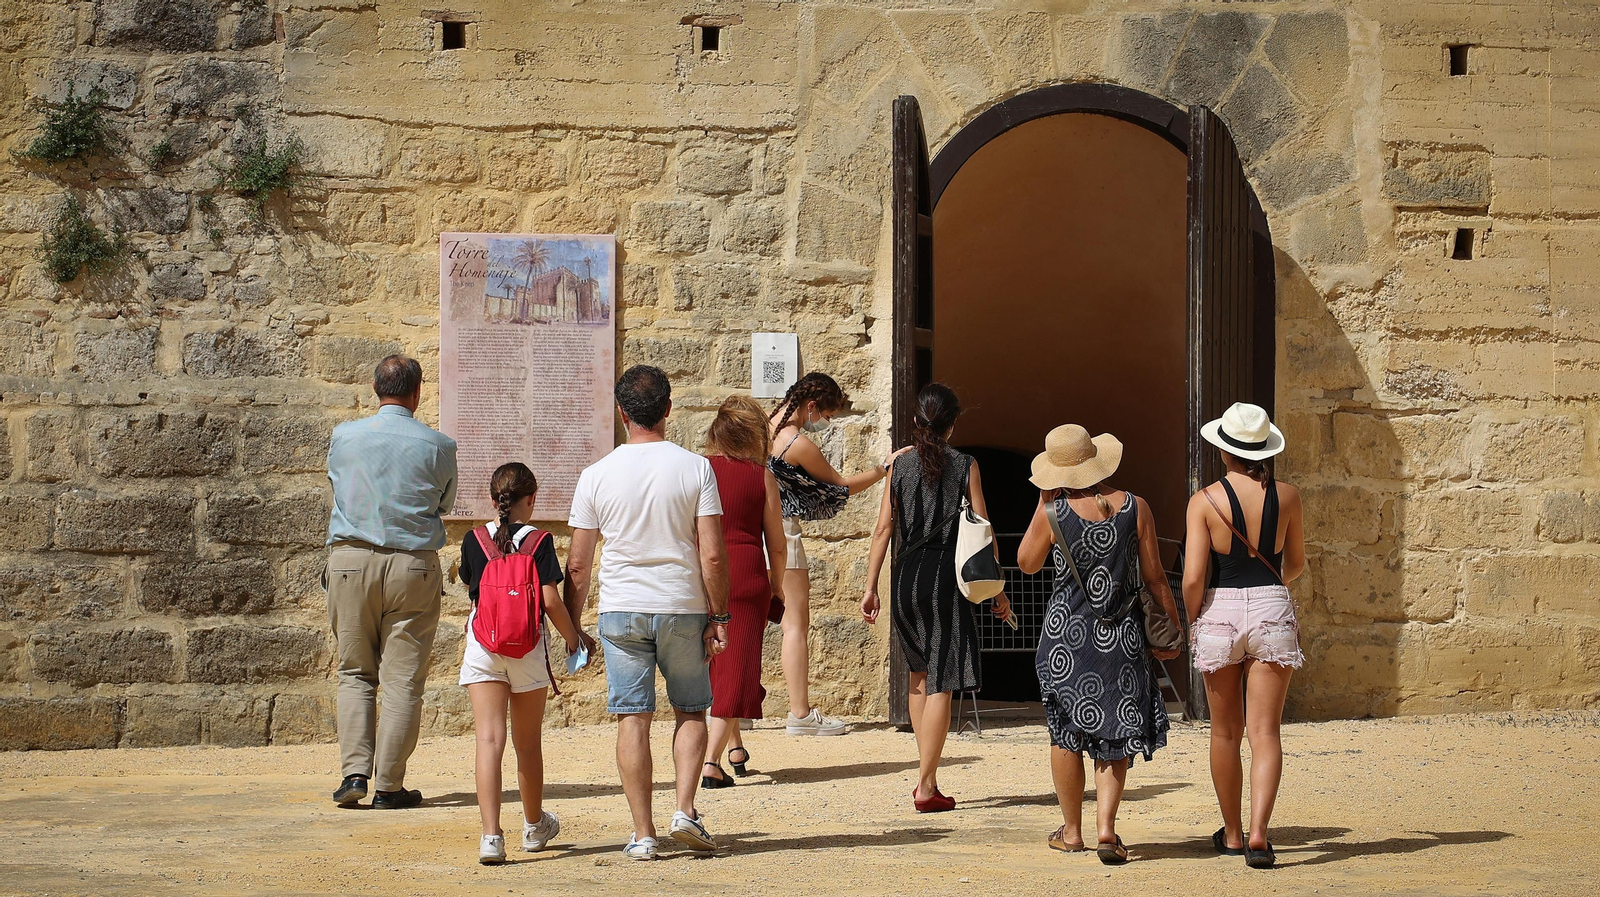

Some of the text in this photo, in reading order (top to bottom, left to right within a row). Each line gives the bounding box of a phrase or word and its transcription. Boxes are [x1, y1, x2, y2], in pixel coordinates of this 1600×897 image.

[445, 237, 490, 260] Torre
[487, 254, 503, 268] del
[448, 262, 518, 288] Homenaje
[453, 508, 474, 517] Jerez
